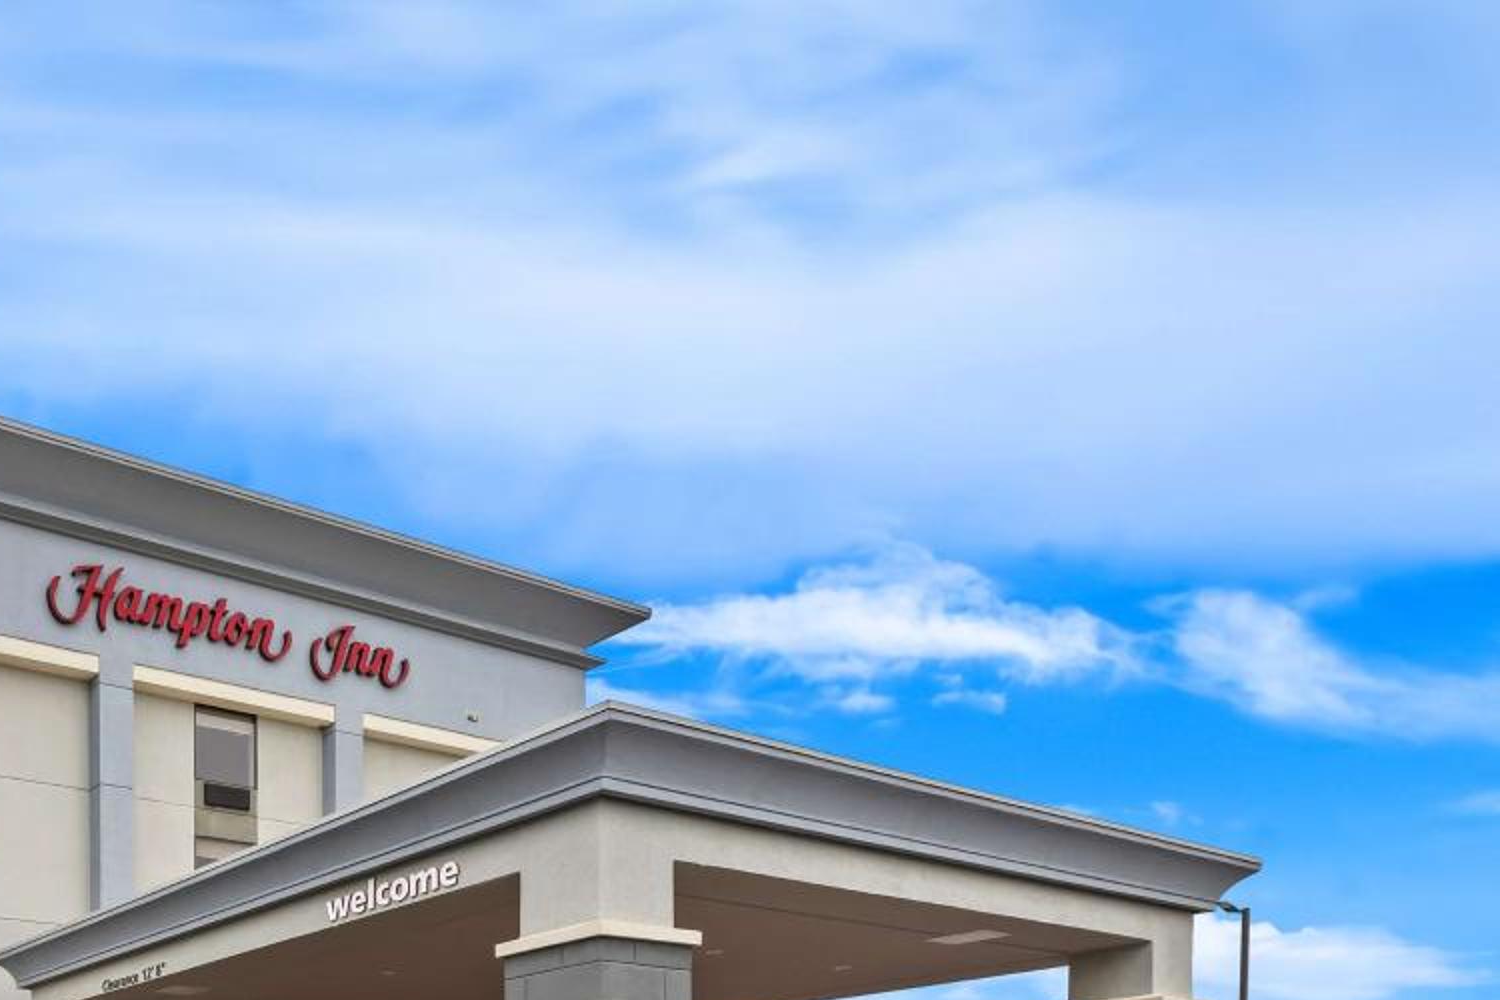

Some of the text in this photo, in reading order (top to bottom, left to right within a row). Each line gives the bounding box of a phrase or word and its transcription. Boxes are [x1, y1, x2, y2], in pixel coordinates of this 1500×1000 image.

[46, 565, 410, 688] Hampton Inn
[325, 860, 460, 921] welcome
[101, 974, 139, 992] Clearance
